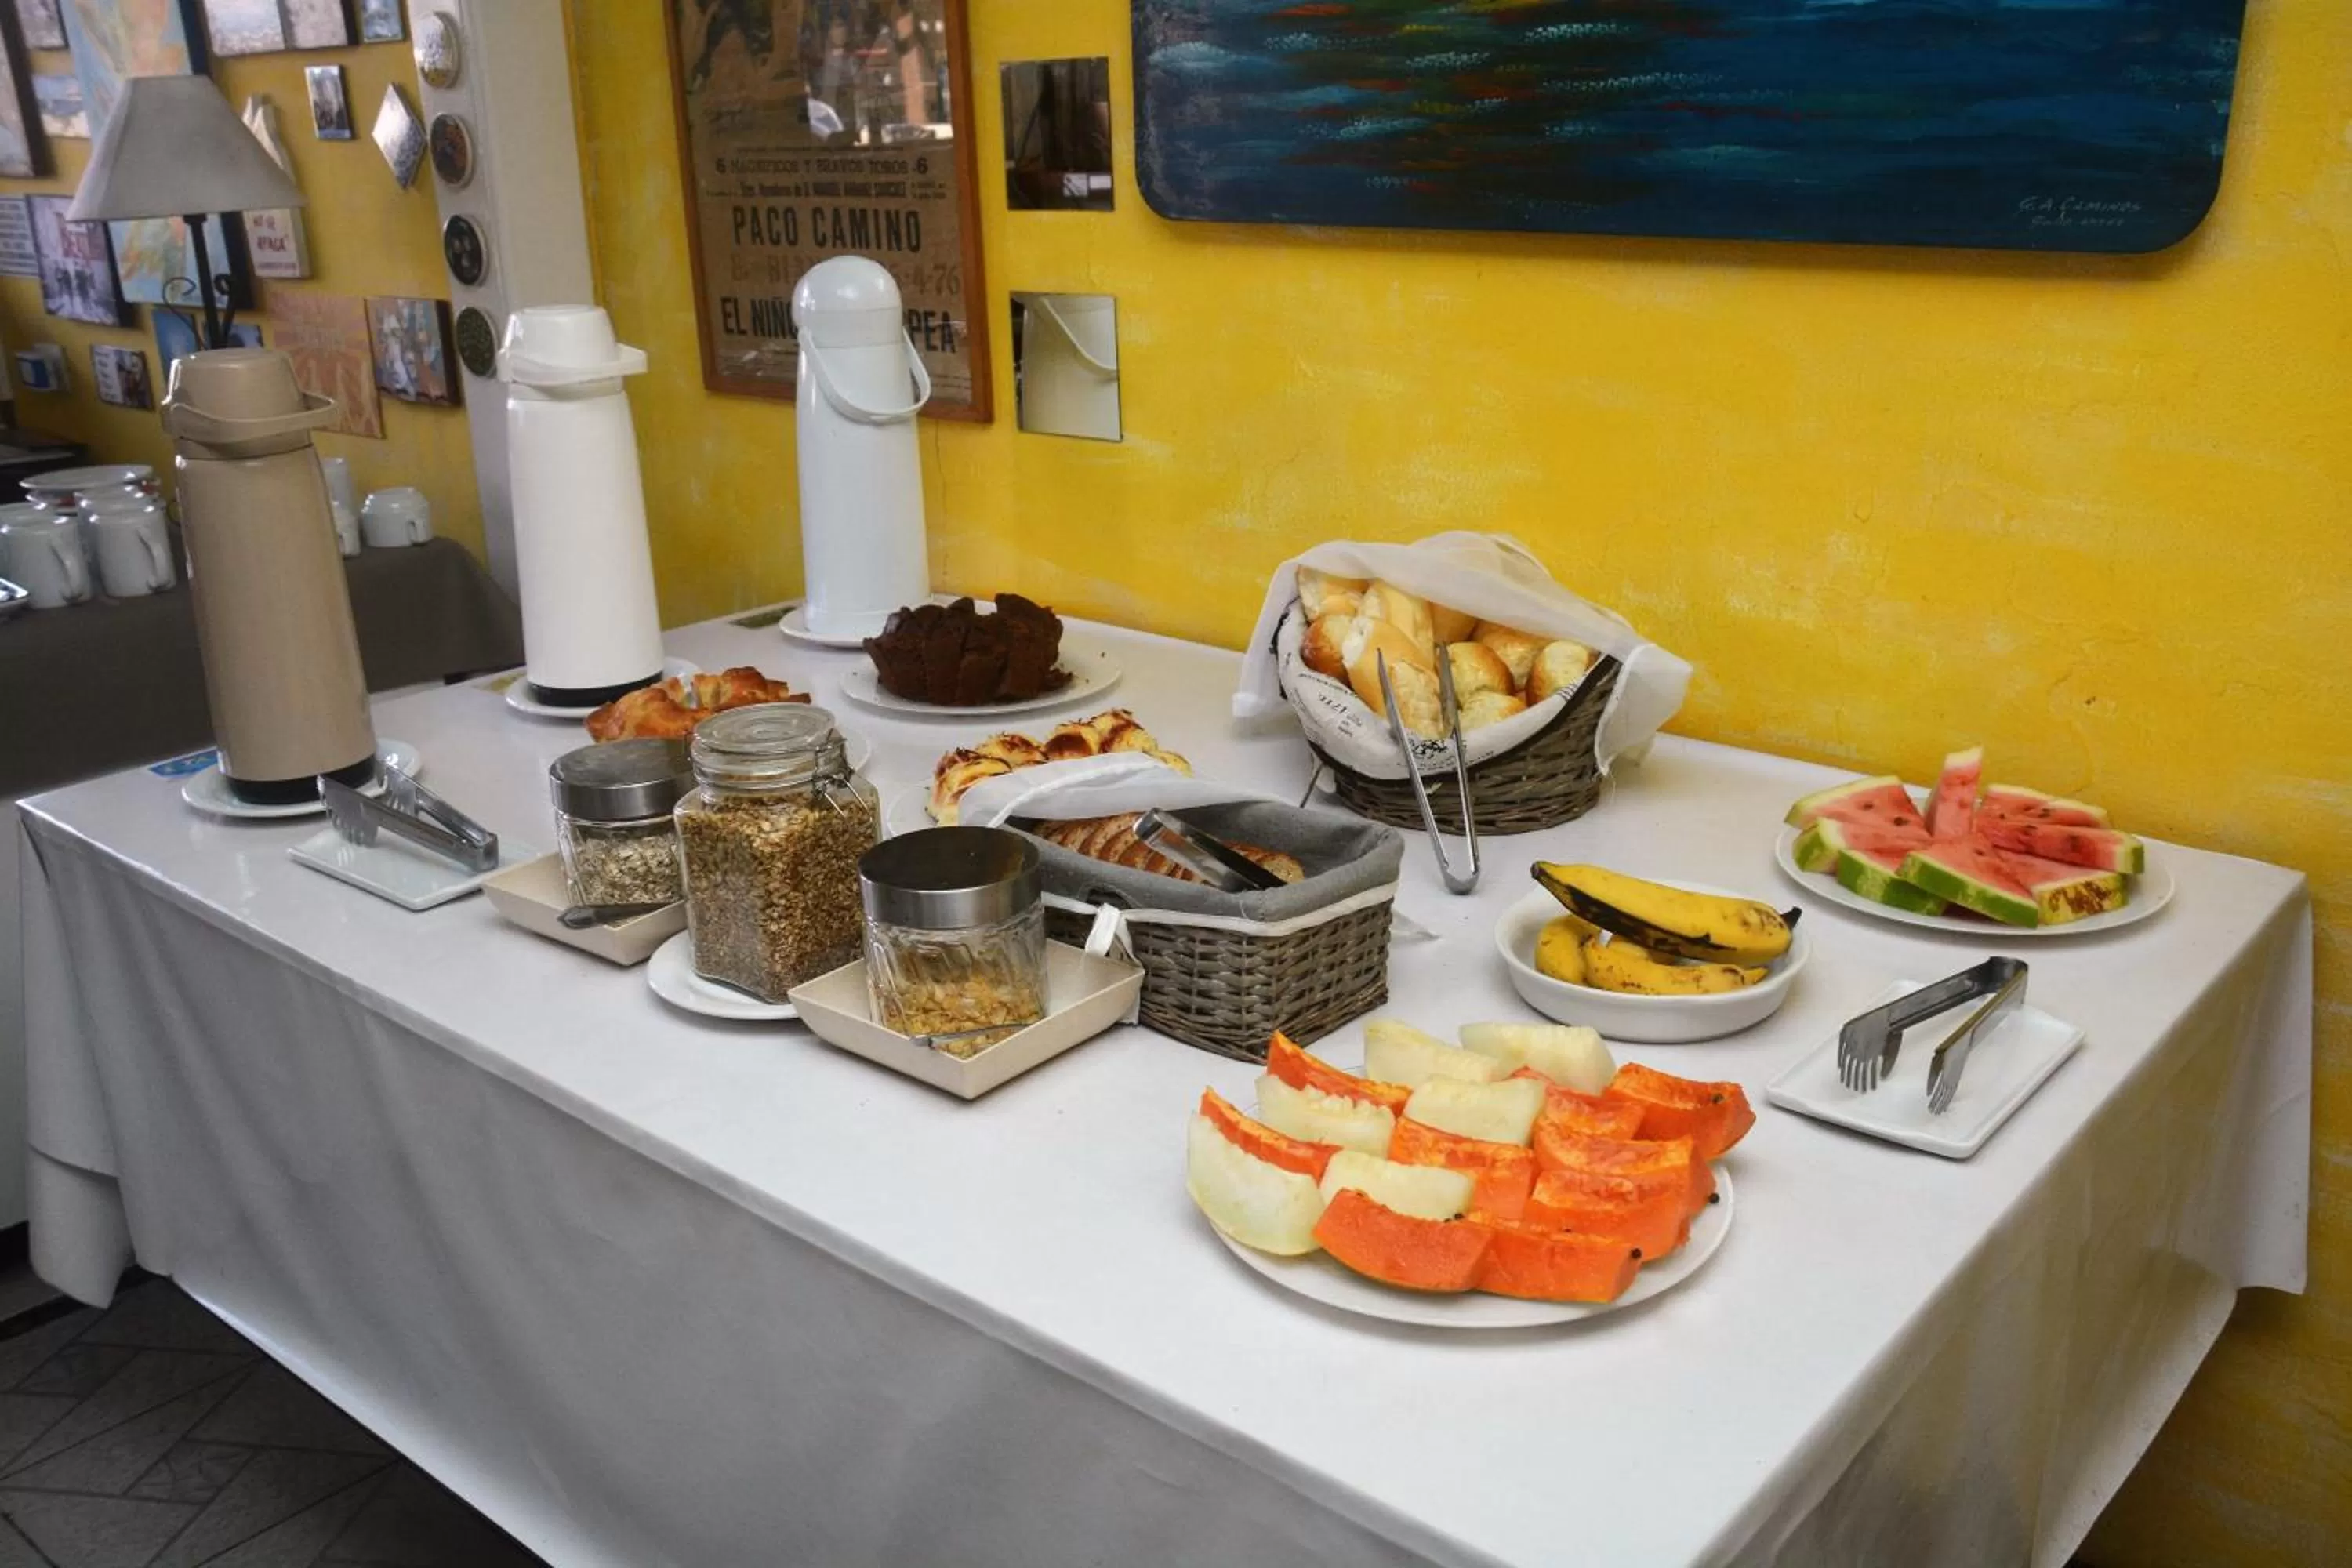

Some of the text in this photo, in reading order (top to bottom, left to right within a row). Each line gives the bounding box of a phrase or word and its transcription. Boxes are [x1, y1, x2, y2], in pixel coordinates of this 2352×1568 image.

[732, 205, 921, 253] PACO CAMINO
[722, 298, 746, 335] EL
[903, 307, 957, 354] PEA
